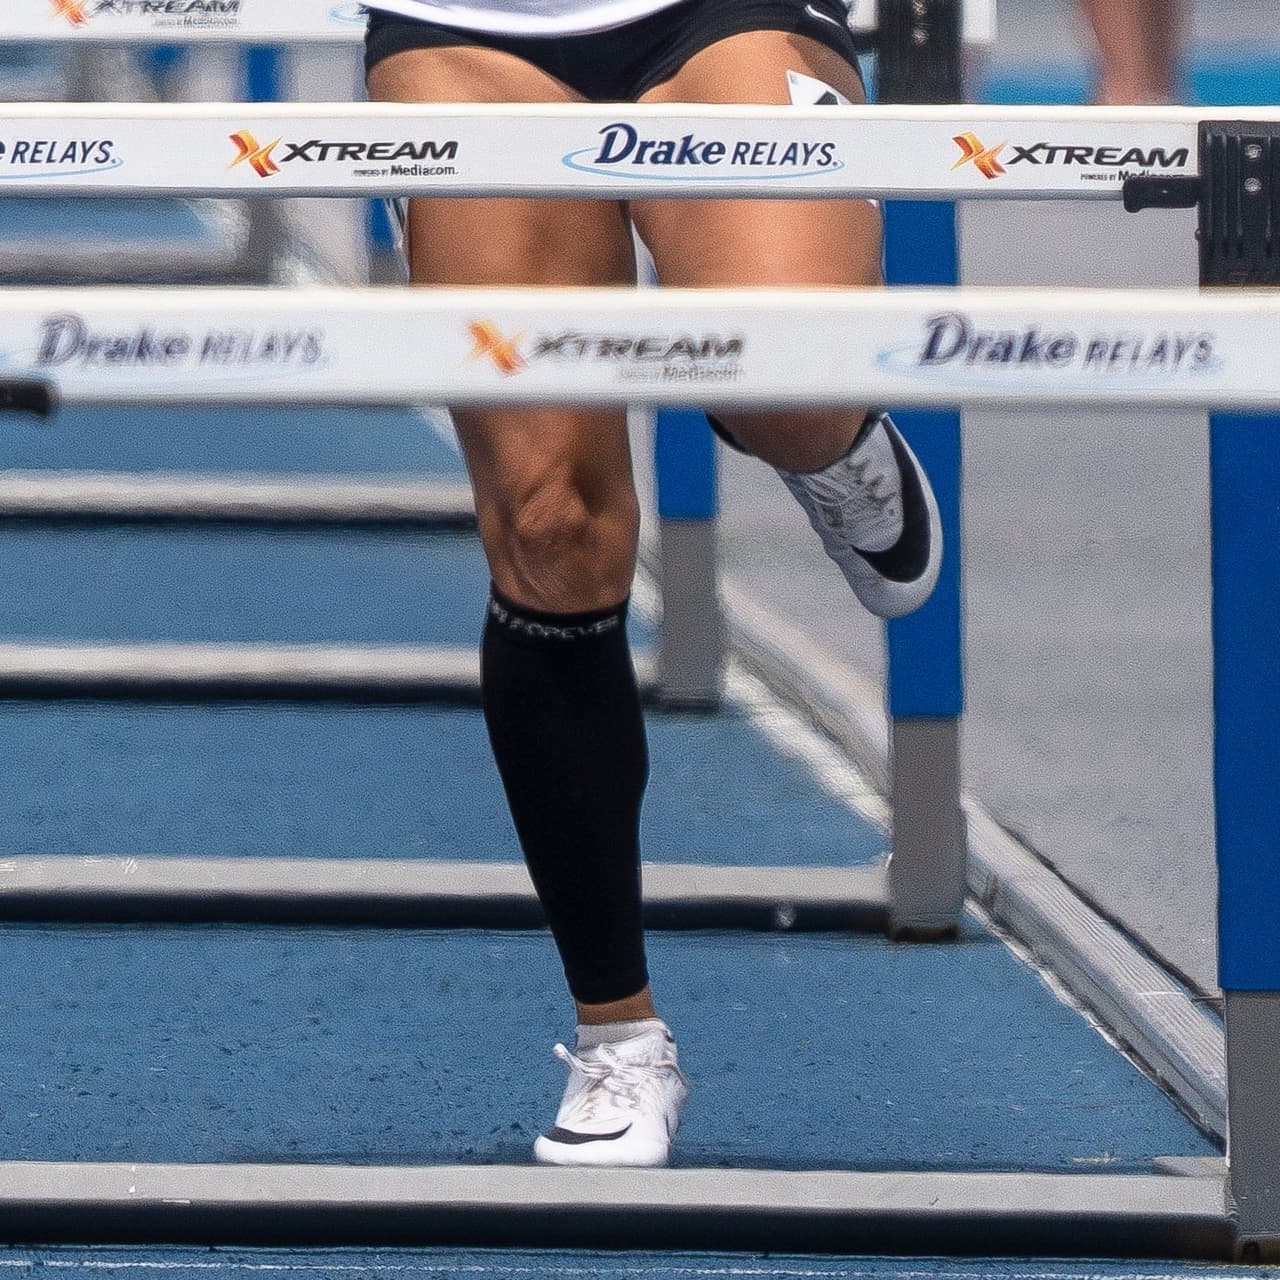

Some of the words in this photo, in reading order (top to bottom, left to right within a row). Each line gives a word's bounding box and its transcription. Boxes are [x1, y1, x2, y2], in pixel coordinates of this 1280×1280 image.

[280, 139, 459, 162] XTREAM
[593, 122, 727, 165] Drake
[1006, 142, 1190, 168] XTREAM
[37, 312, 192, 367] Drake
[529, 330, 745, 364] XTREAM
[919, 311, 1077, 366] Drake
